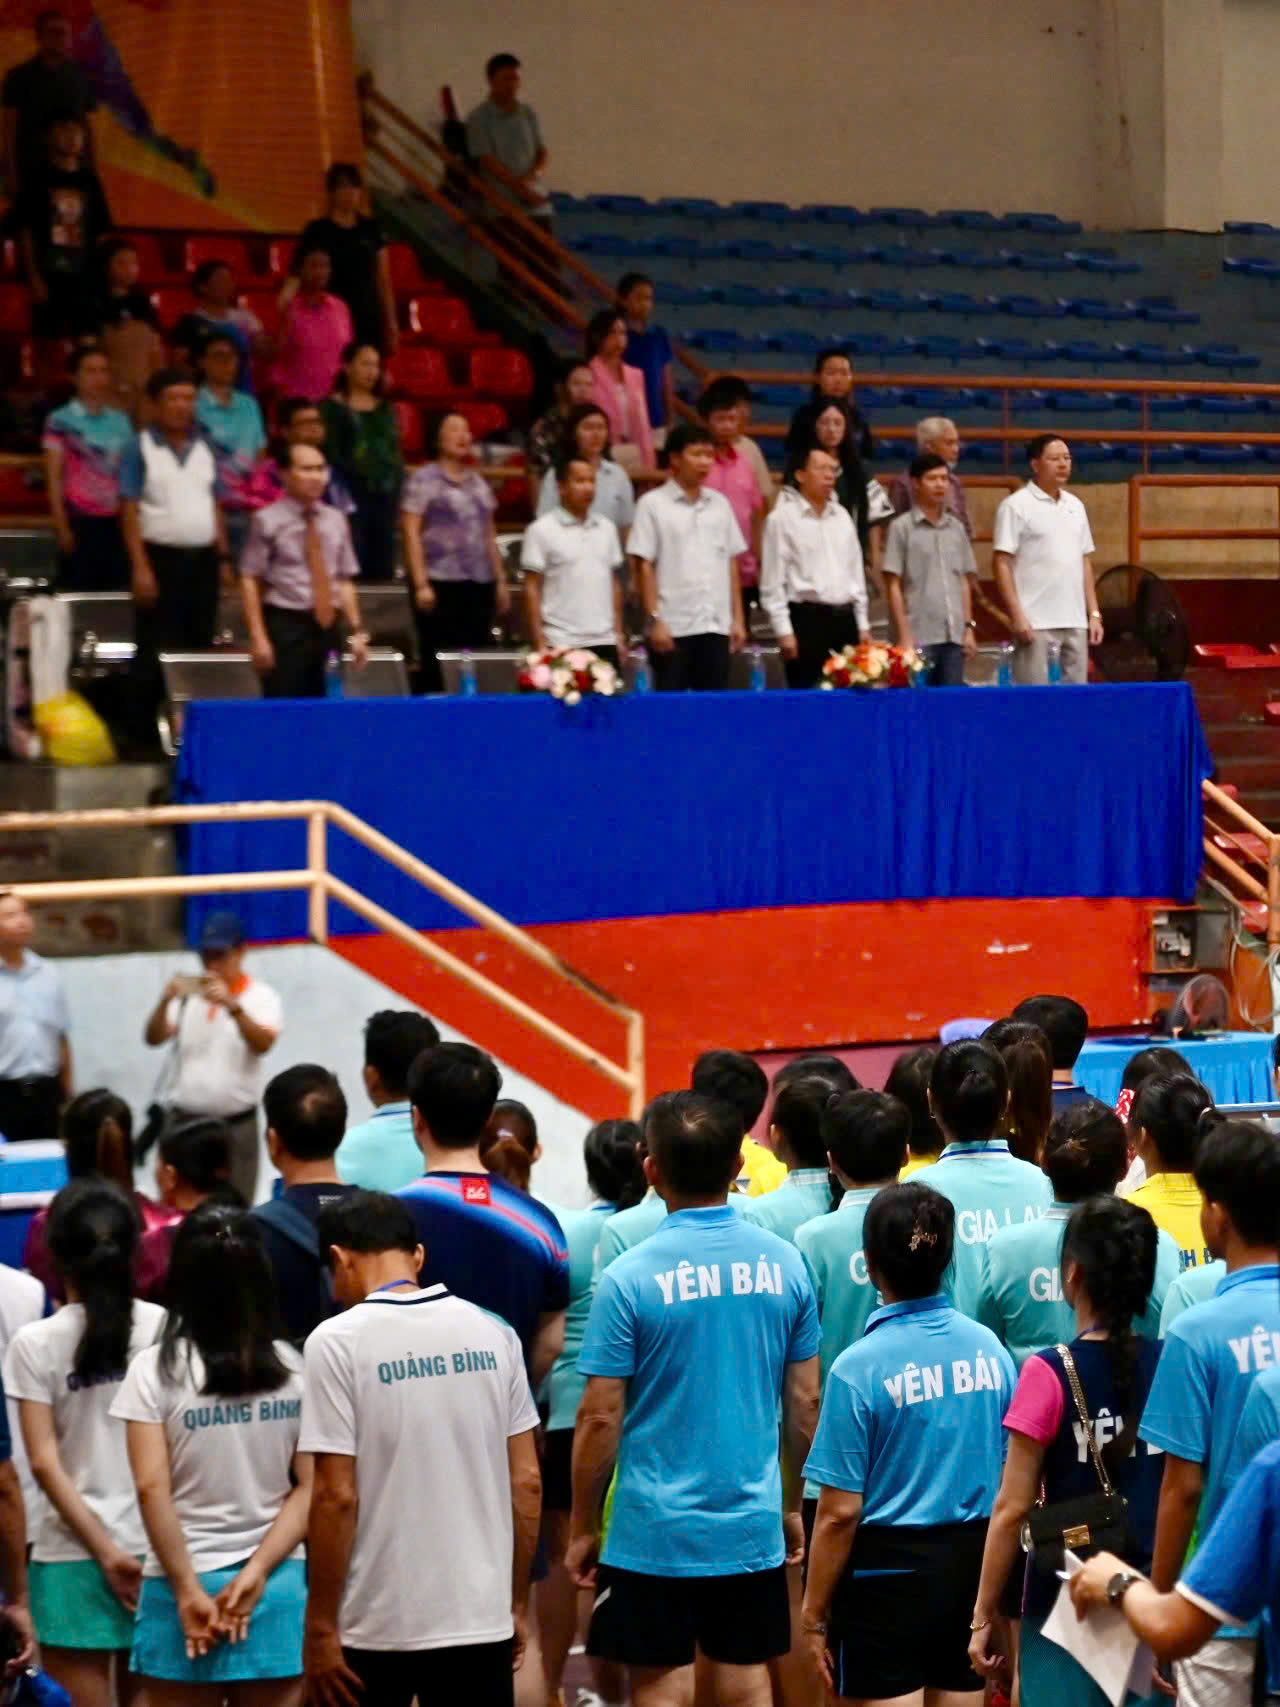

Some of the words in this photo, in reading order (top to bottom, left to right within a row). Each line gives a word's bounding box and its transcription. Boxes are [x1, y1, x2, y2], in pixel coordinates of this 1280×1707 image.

[655, 1261, 721, 1304] YÊN
[731, 1254, 783, 1296] BÁI
[377, 1351, 447, 1386] QUẢNG
[452, 1347, 498, 1374] BÌNH
[883, 1363, 944, 1409] YÊN
[952, 1350, 1001, 1395] BÁI
